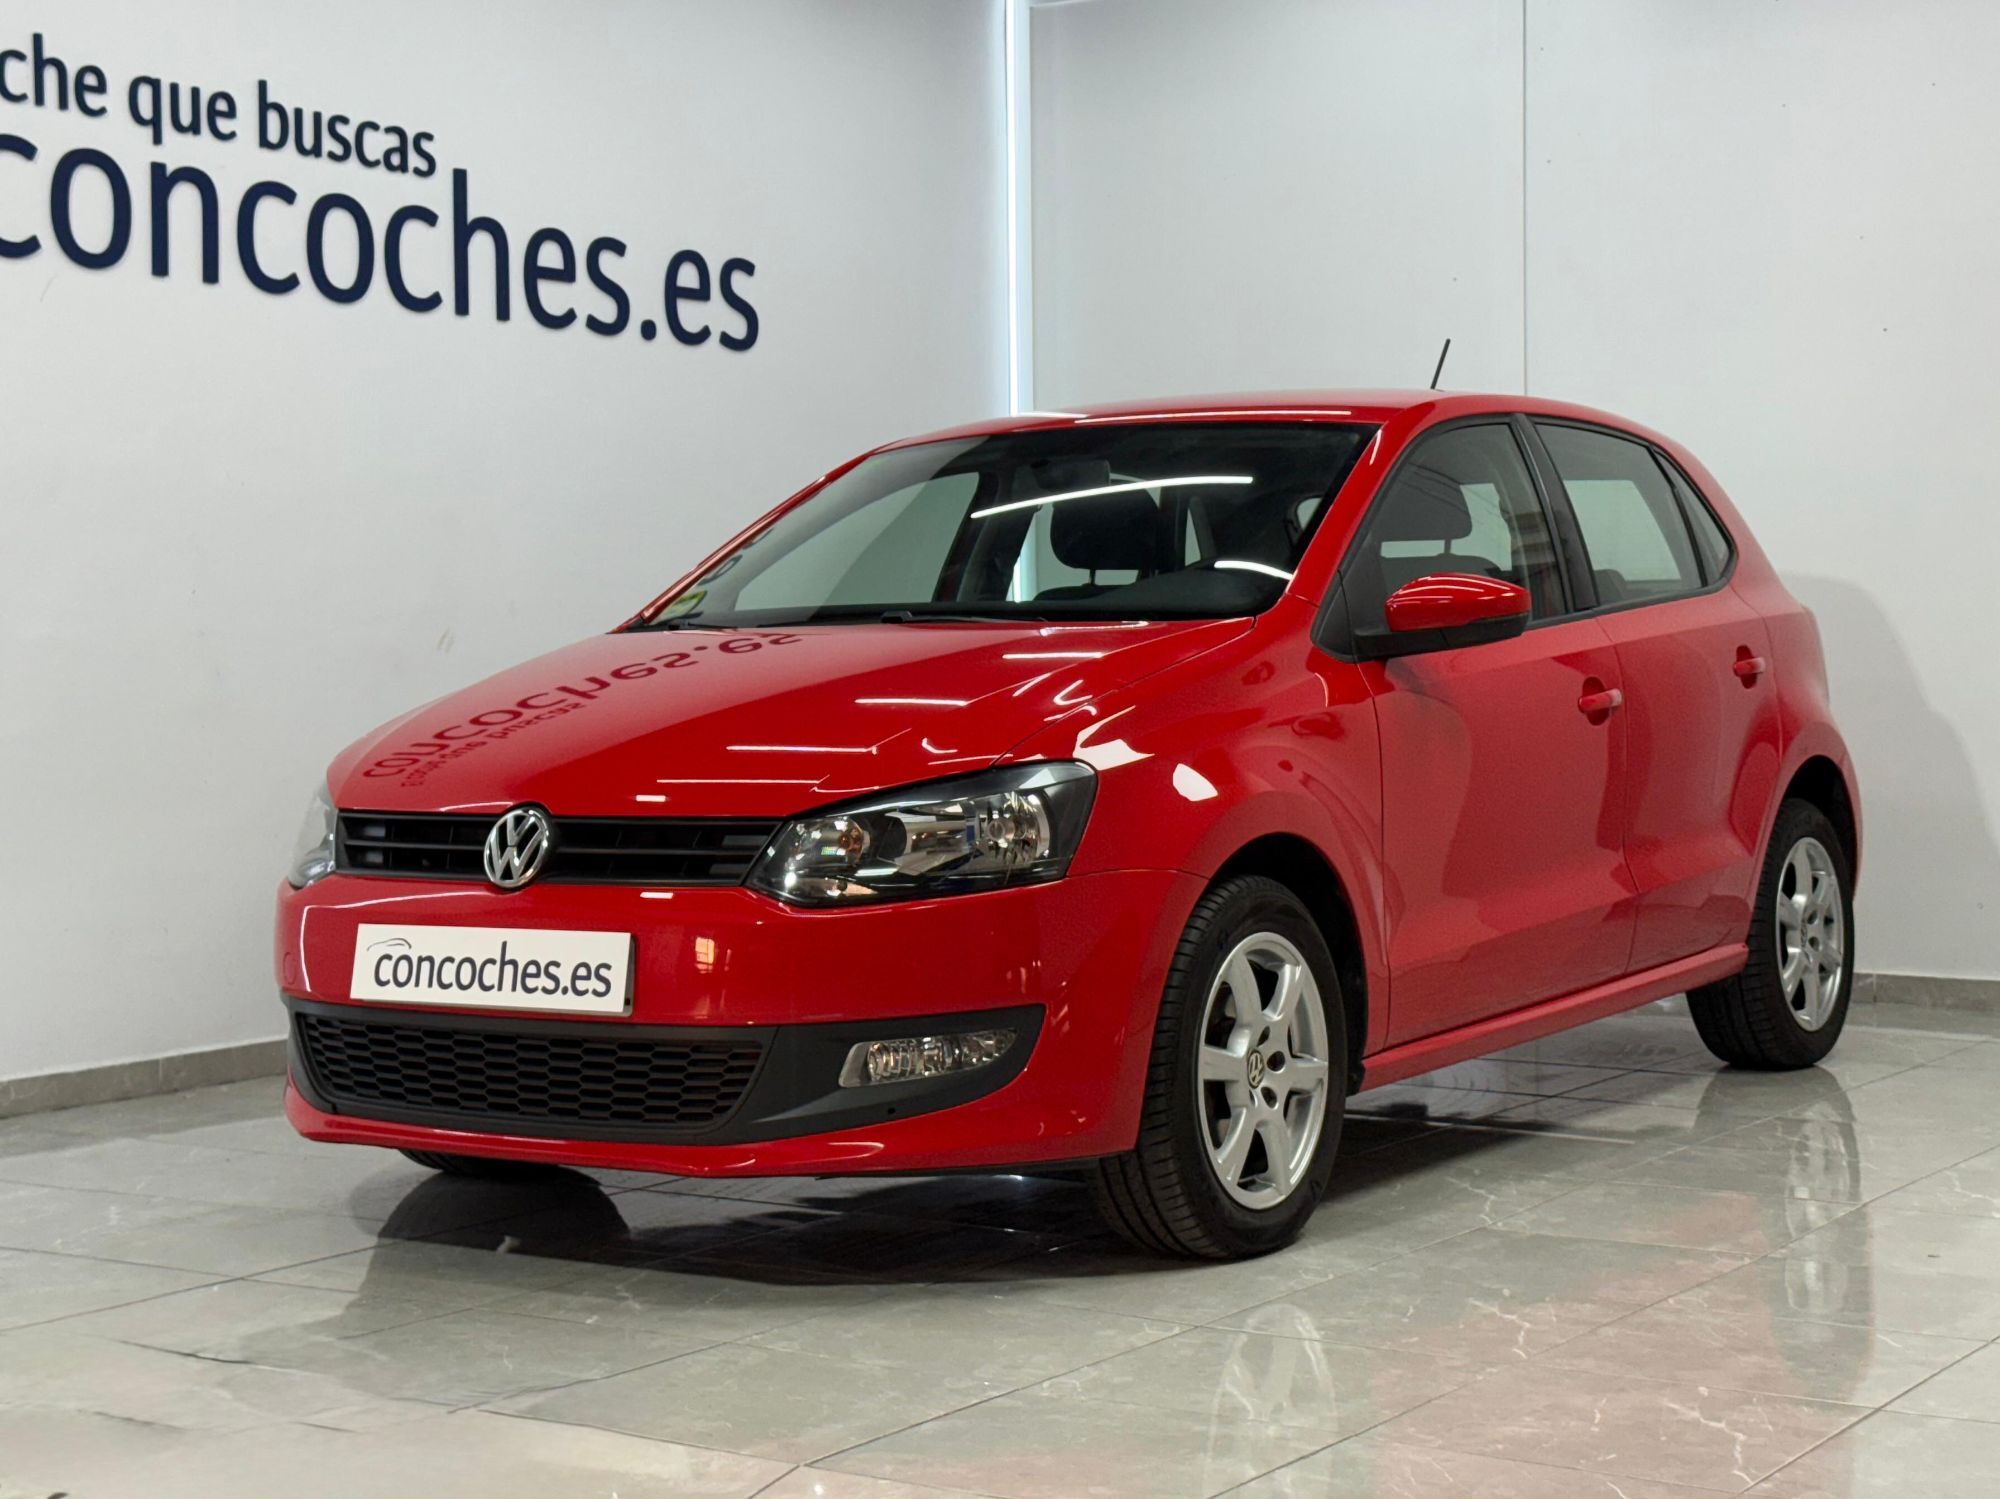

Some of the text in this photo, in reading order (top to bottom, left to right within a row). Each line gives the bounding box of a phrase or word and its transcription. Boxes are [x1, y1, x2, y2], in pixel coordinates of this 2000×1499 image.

[0, 32, 437, 179] che que buscas
[374, 940, 613, 998] concoches.es
